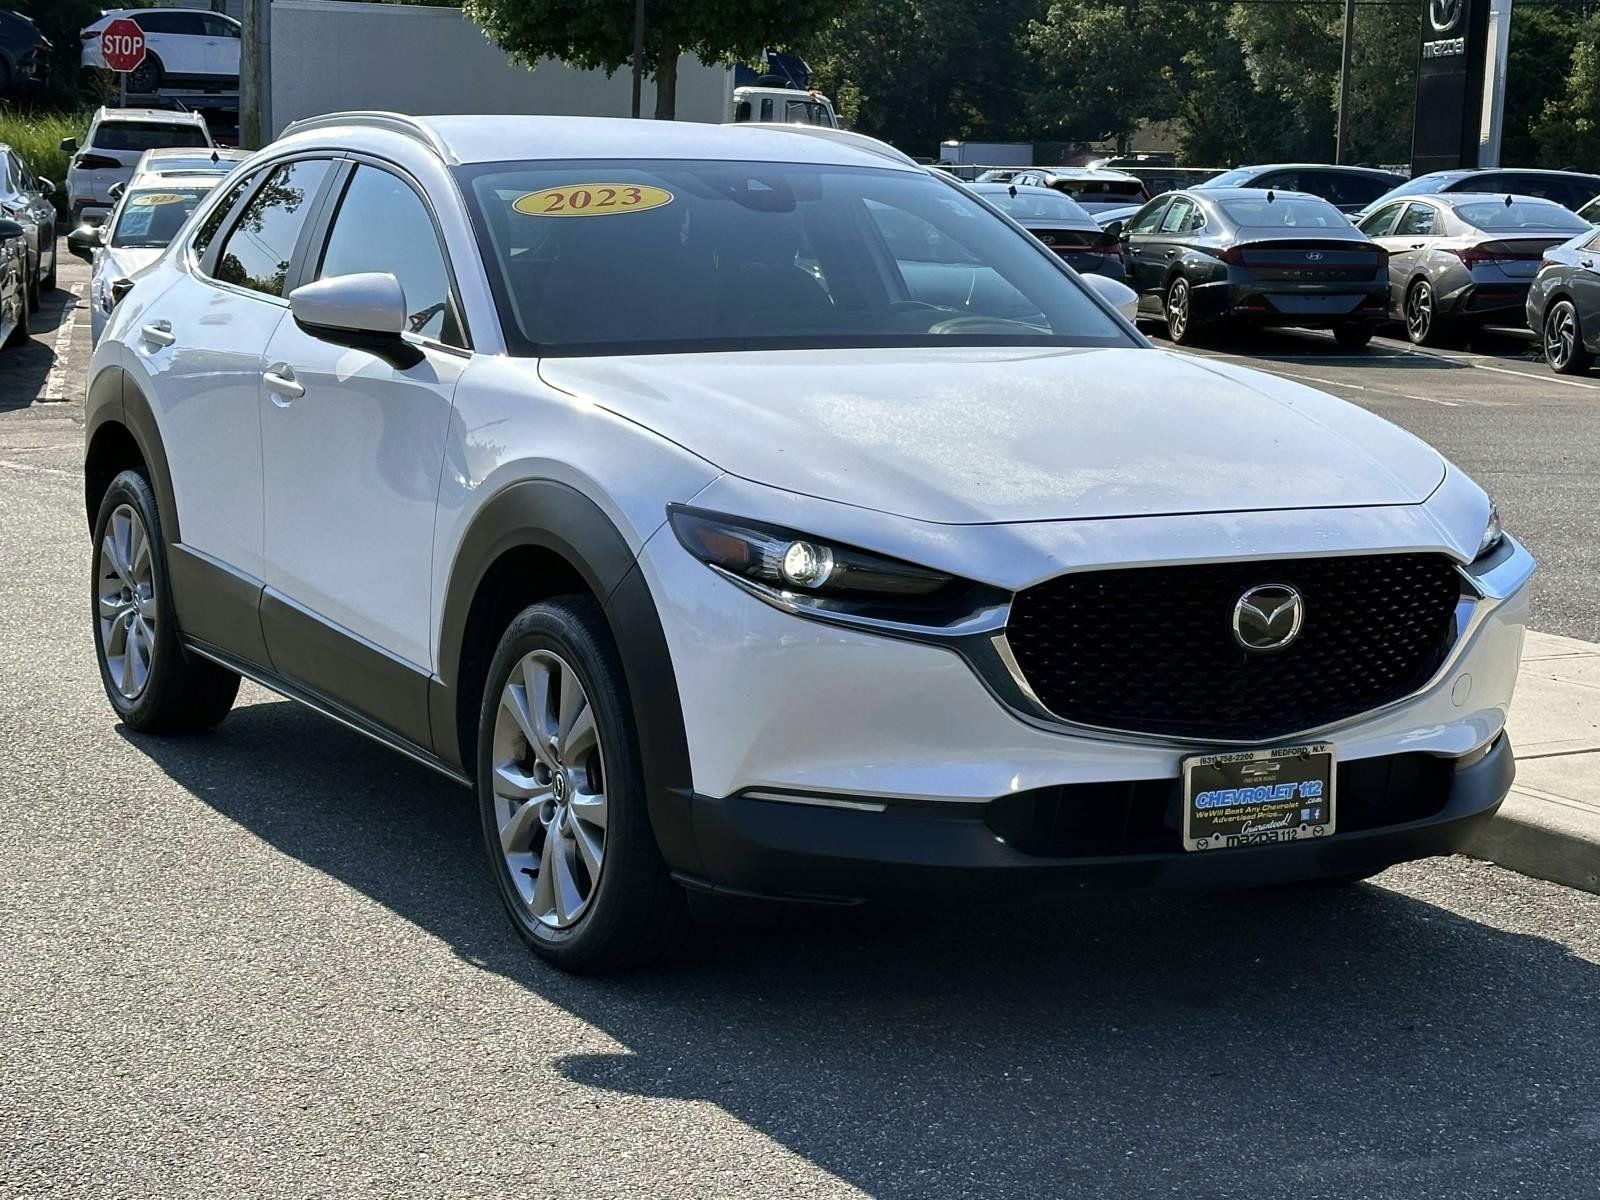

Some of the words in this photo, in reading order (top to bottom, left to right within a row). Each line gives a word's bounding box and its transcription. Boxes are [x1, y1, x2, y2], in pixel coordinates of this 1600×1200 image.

[104, 35, 143, 55] STOP
[543, 187, 642, 213] 2023
[1195, 782, 1298, 809] CHEVROLET
[1299, 780, 1323, 798] 112
[1245, 806, 1260, 815] Any
[1262, 802, 1299, 811] Chevrolet
[1212, 815, 1257, 824] Advertised
[1281, 829, 1298, 841] 112
